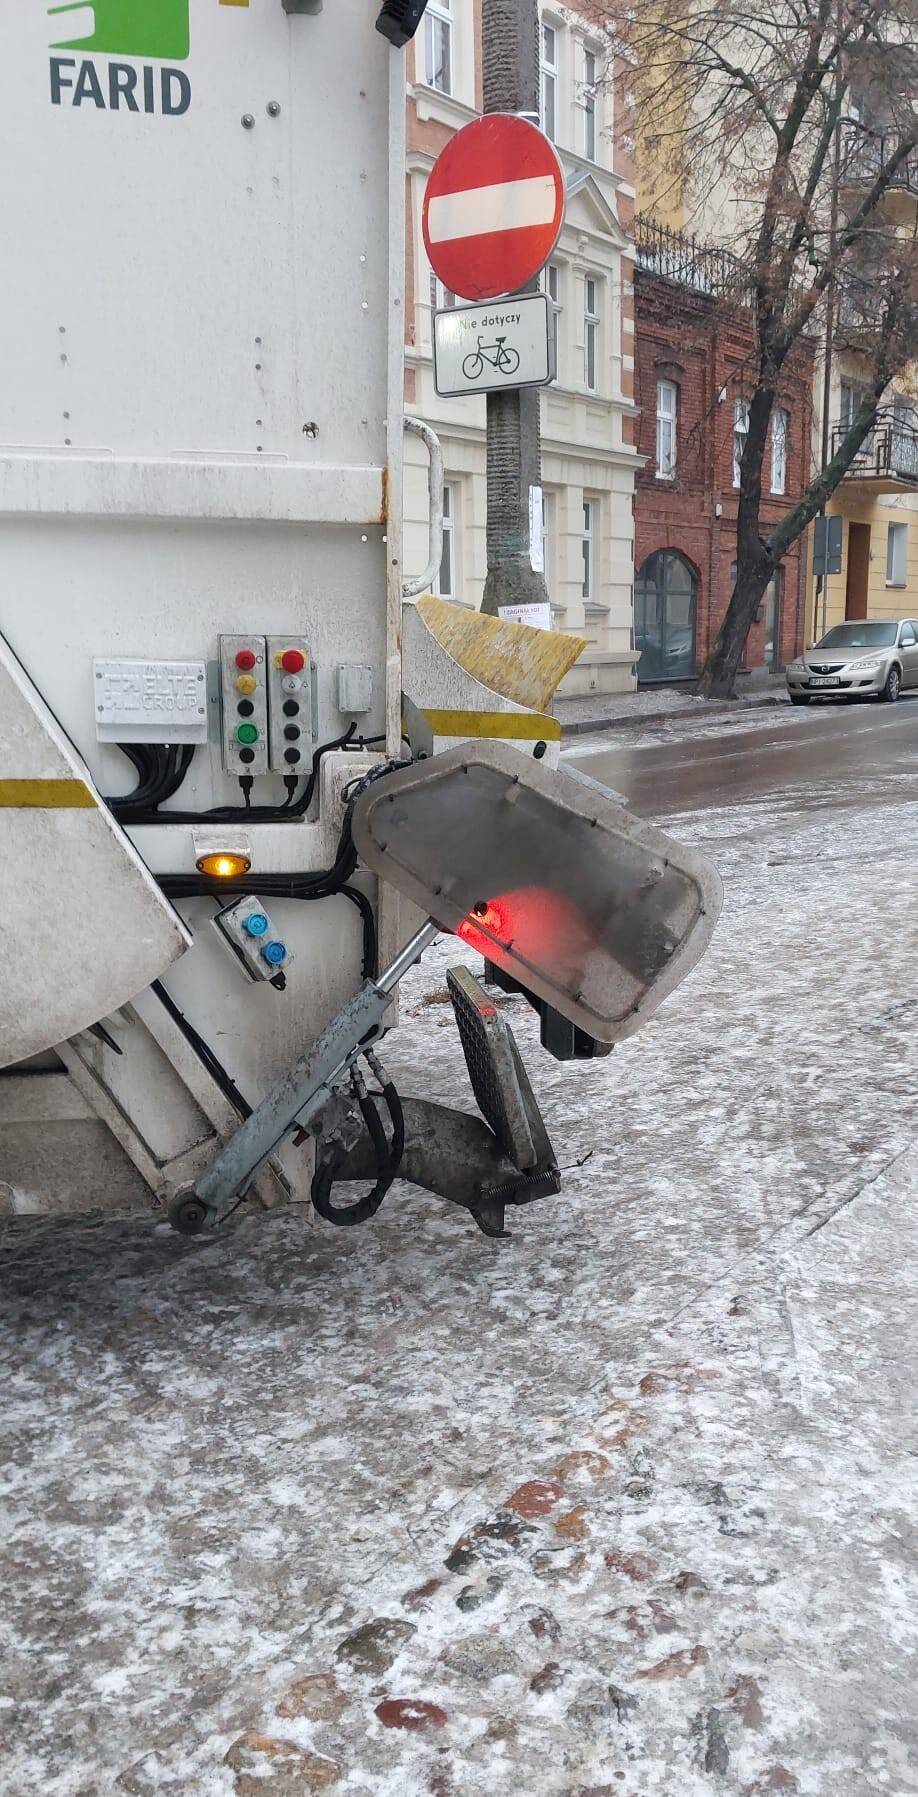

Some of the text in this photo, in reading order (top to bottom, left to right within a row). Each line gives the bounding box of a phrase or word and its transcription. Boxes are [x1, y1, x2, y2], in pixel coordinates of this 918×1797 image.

[49, 56, 192, 116] FARID
[460, 313, 521, 329] Nie dotyczy
